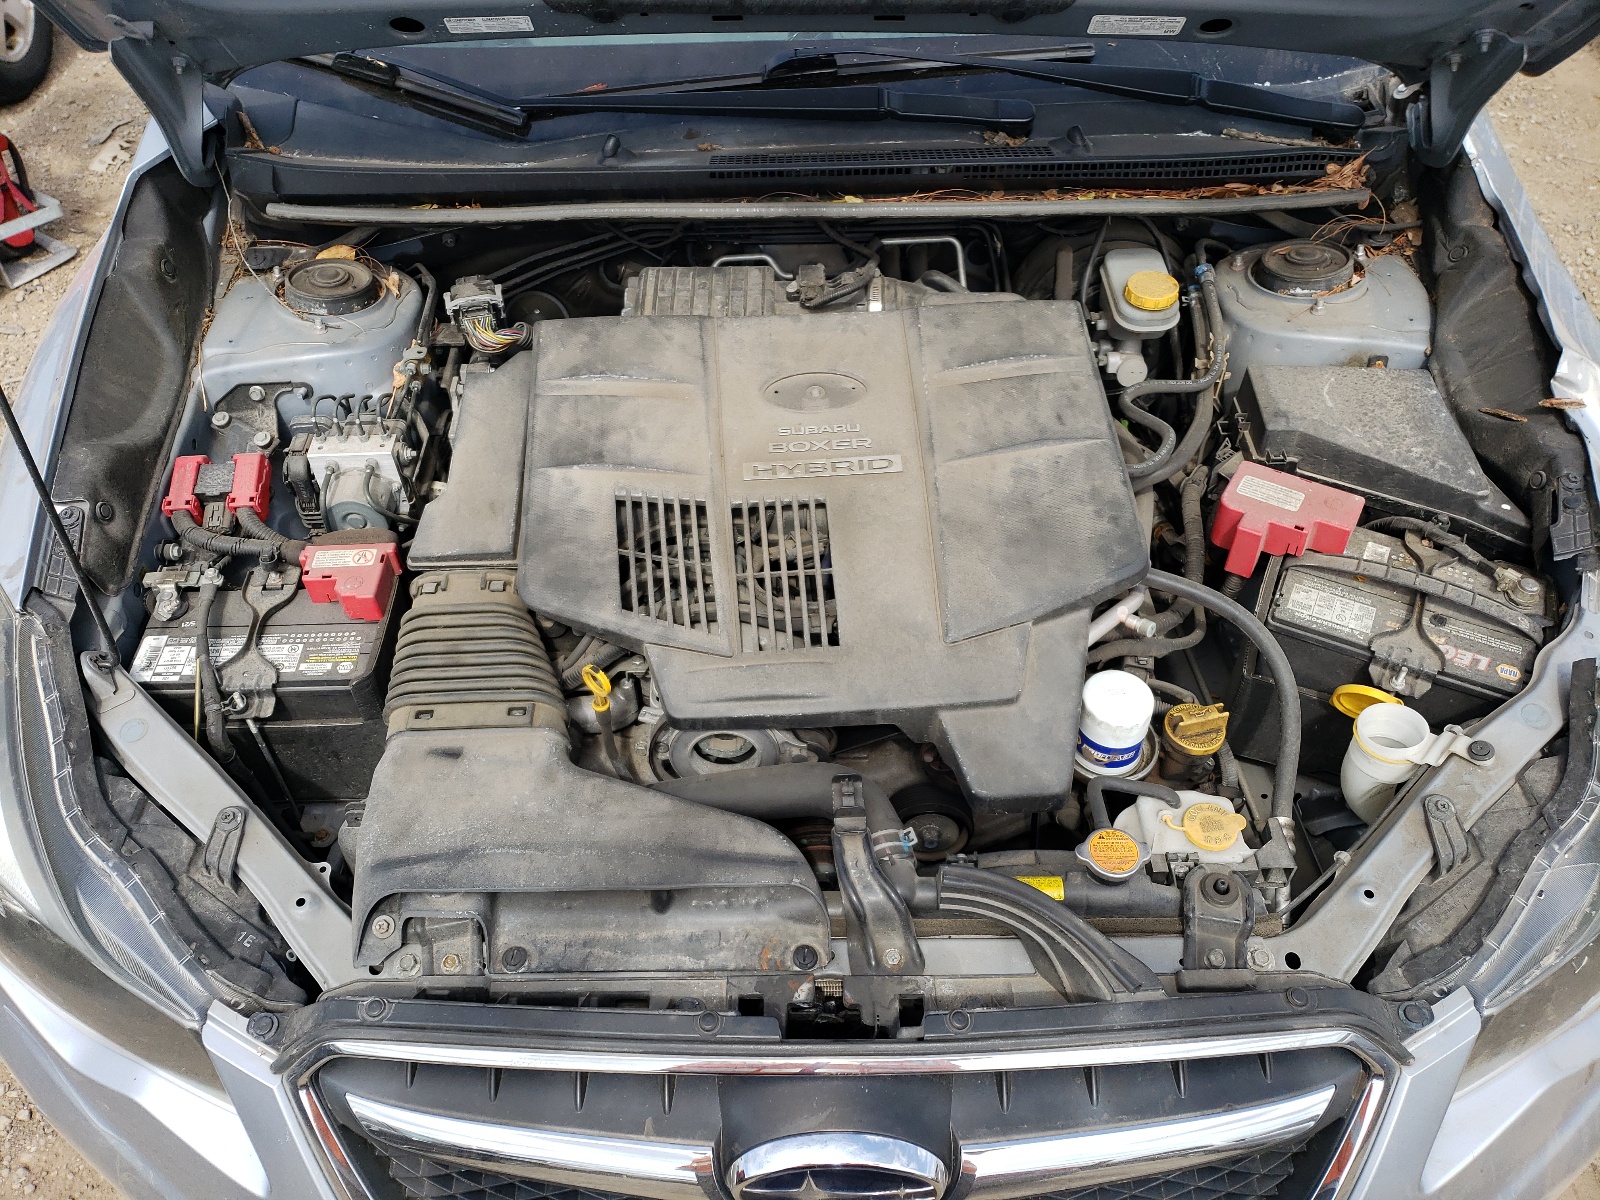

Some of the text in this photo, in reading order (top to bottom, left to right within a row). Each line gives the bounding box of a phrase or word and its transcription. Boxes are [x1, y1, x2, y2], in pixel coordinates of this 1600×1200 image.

[778, 423, 860, 436] SUBARU
[768, 437, 872, 453] BOXER
[752, 458, 894, 477] HYBRID
[1499, 666, 1519, 678] NAPA
